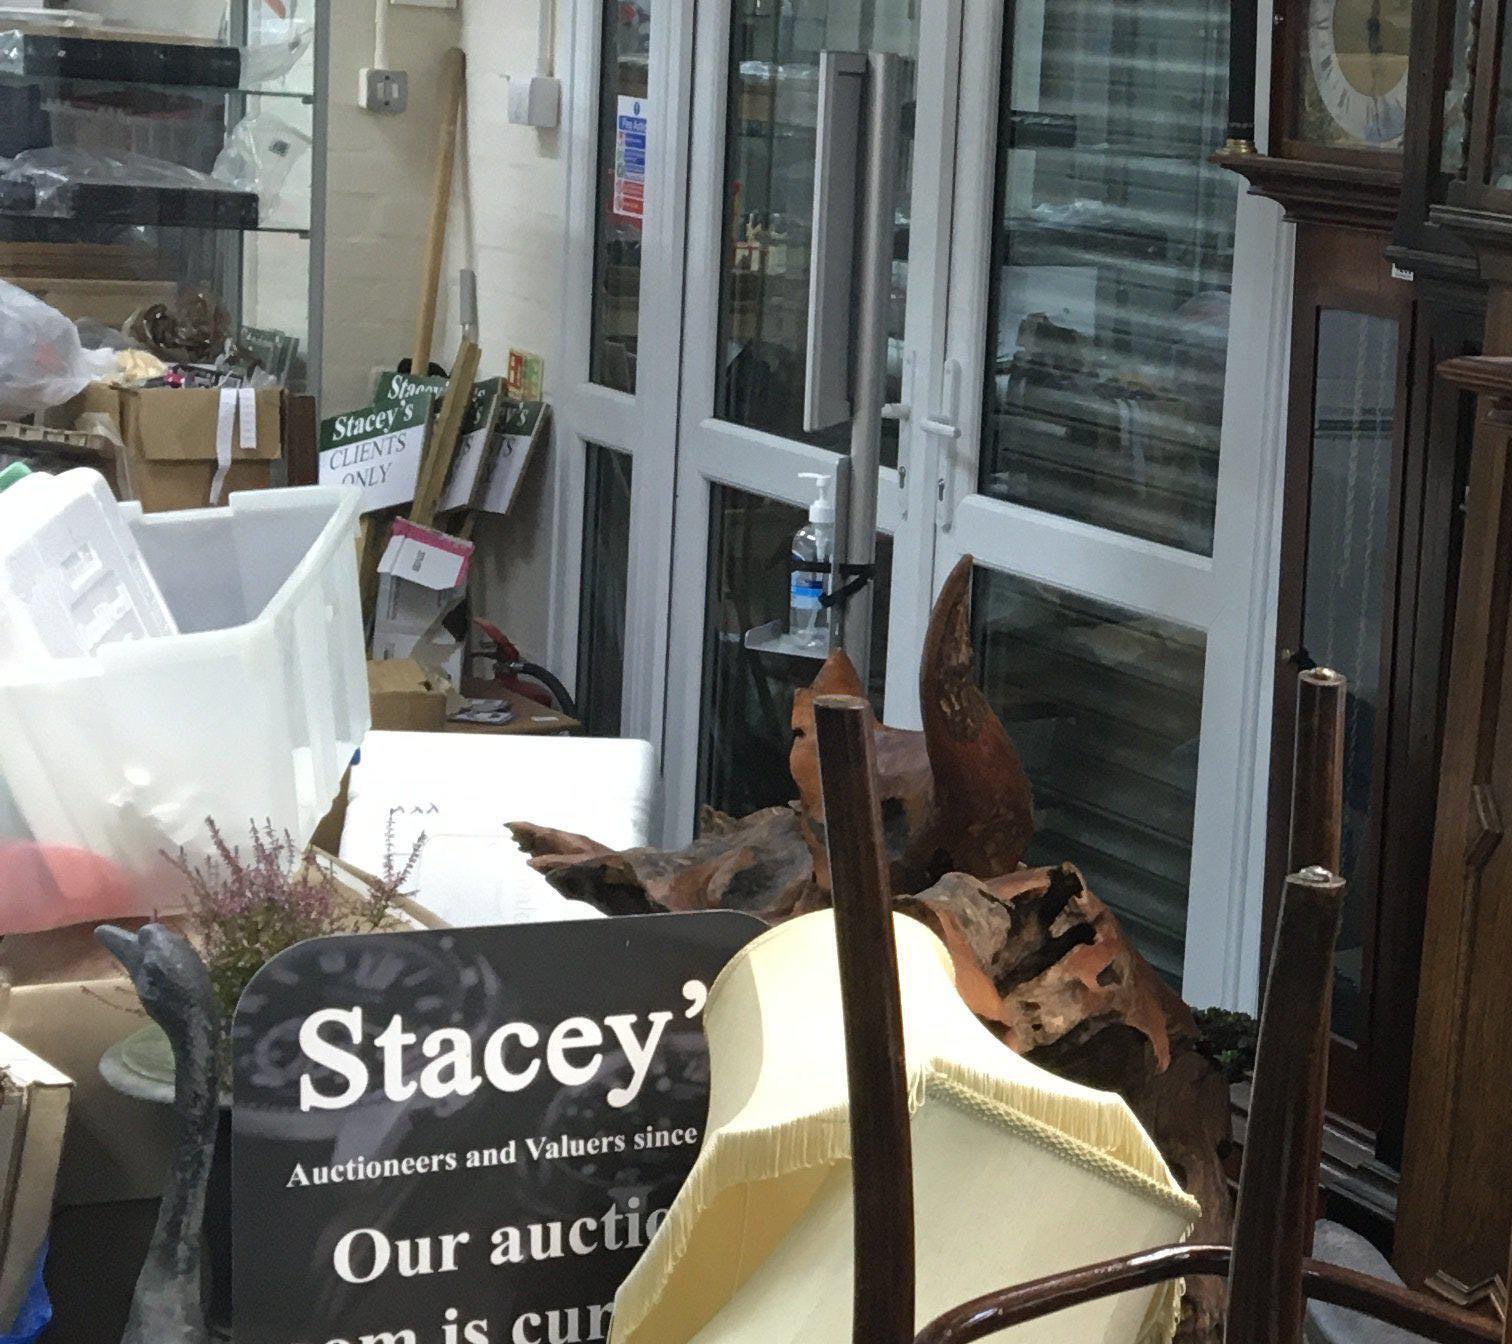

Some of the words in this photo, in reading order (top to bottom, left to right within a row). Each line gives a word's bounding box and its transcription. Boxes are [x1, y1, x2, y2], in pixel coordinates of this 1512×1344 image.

[332, 398, 414, 442] Stacey's
[329, 431, 406, 471] CLIENTS
[299, 978, 709, 1112] Stacey'
[285, 1152, 457, 1188] Auctioneers
[465, 1139, 518, 1169] and
[525, 1130, 626, 1162] Valuers
[632, 1124, 699, 1150] since
[332, 1227, 471, 1285] Our
